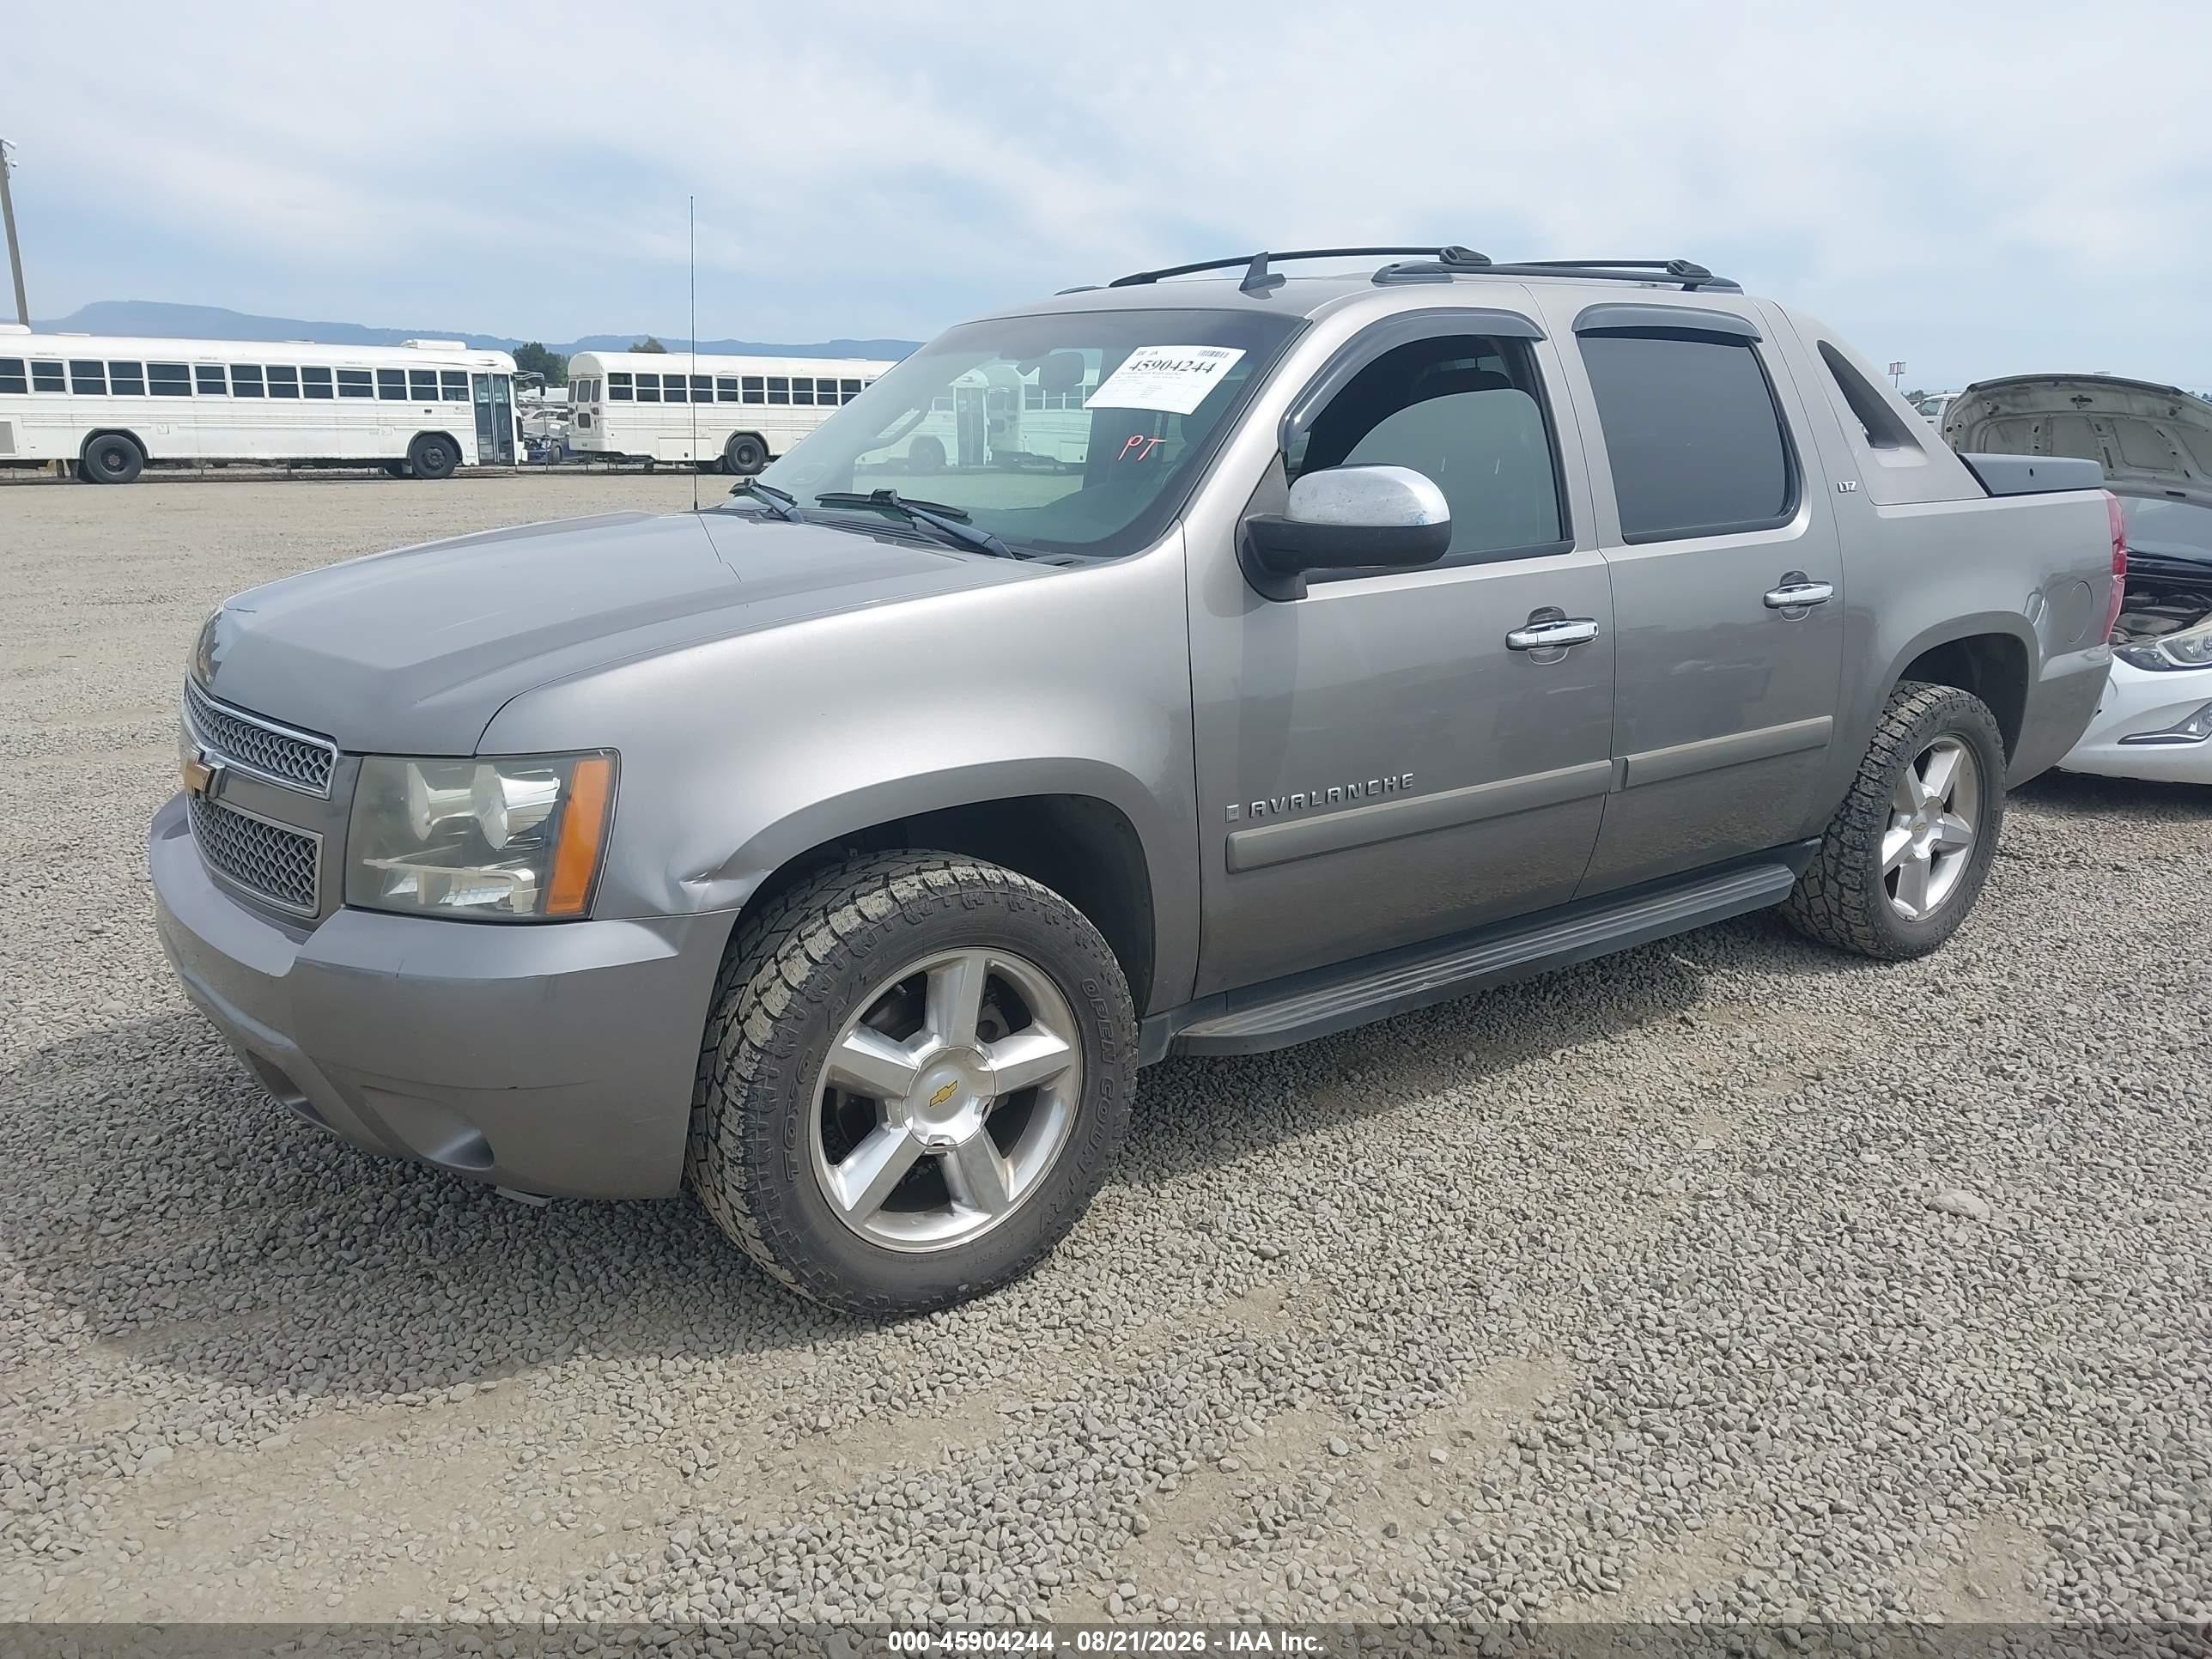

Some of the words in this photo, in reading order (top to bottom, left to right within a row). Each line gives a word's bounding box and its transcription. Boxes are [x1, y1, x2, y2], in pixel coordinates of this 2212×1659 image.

[1129, 359, 1217, 374] 45904244
[1118, 434, 1167, 461] PT
[1838, 481, 1856, 493] LTZ
[1249, 773, 1415, 817] AVALANCHE
[1082, 978, 1115, 1064] OPEN
